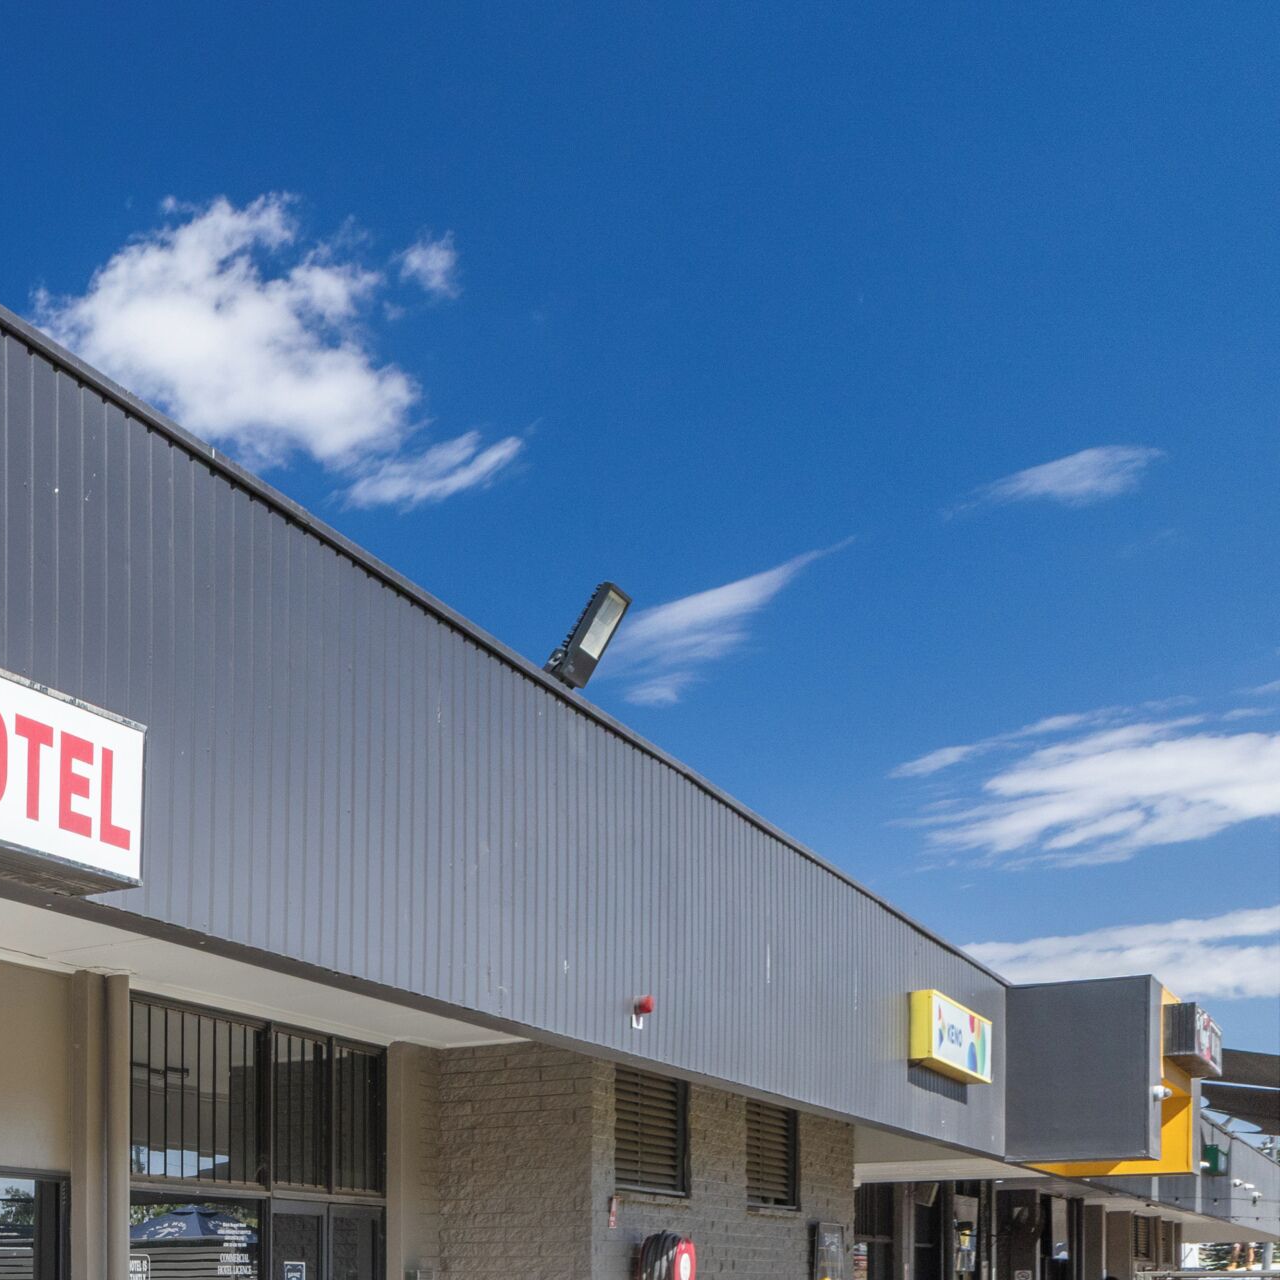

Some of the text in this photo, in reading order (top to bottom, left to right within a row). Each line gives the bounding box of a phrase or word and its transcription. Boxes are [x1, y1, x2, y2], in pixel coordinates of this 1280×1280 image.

[947, 1023, 963, 1048] KENO
[220, 1254, 250, 1262] COMMERCIAL
[142, 1260, 148, 1272] IS
[218, 1266, 232, 1274] HOTEL
